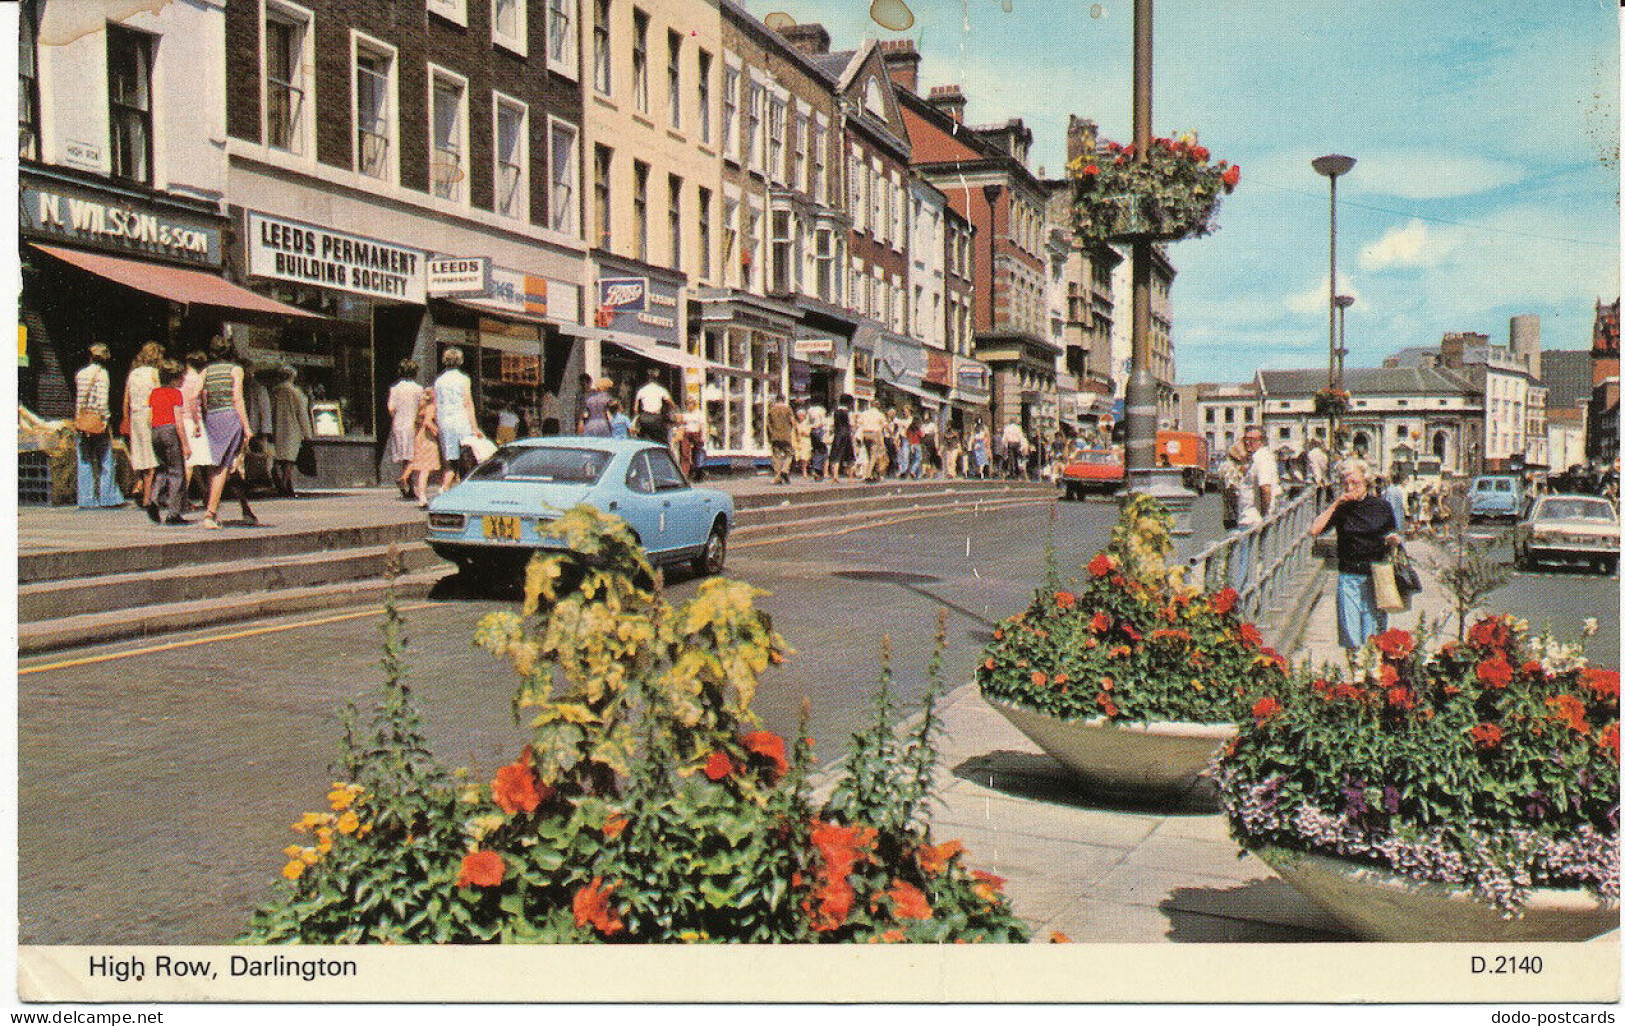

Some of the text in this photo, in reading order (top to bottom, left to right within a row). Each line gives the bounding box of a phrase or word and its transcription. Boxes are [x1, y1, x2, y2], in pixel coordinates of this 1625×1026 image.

[69, 197, 158, 243] WILSON
[261, 220, 417, 276] LEEDS PERMANENT
[432, 261, 479, 274] LEEDS
[275, 252, 408, 297] BUILDING SOCIETY
